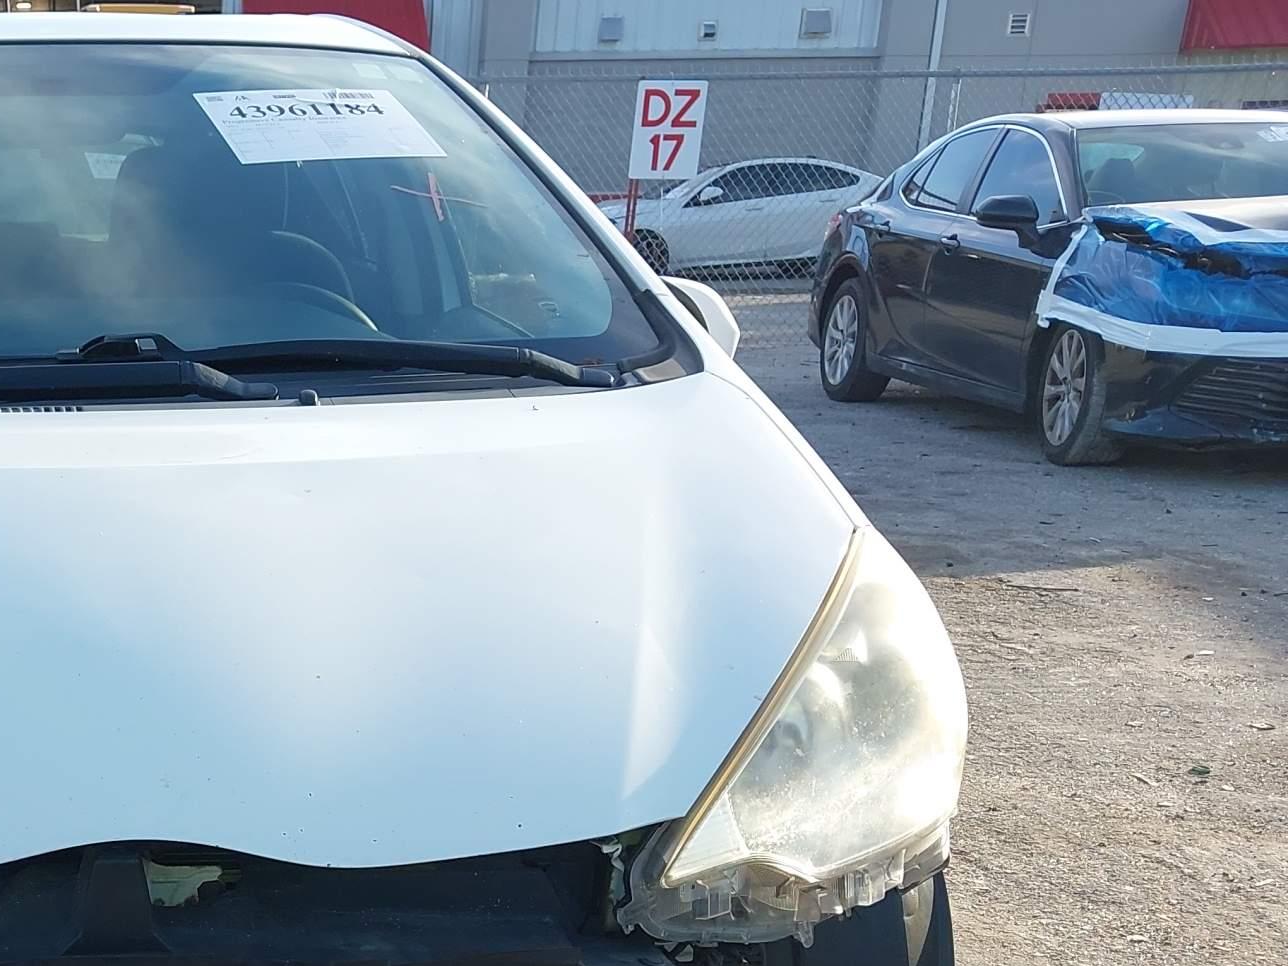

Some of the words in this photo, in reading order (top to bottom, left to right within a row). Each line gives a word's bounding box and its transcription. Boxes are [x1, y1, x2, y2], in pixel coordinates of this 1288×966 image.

[229, 102, 385, 118] 43961184
[641, 88, 701, 128] DZ
[649, 133, 685, 171] 17
